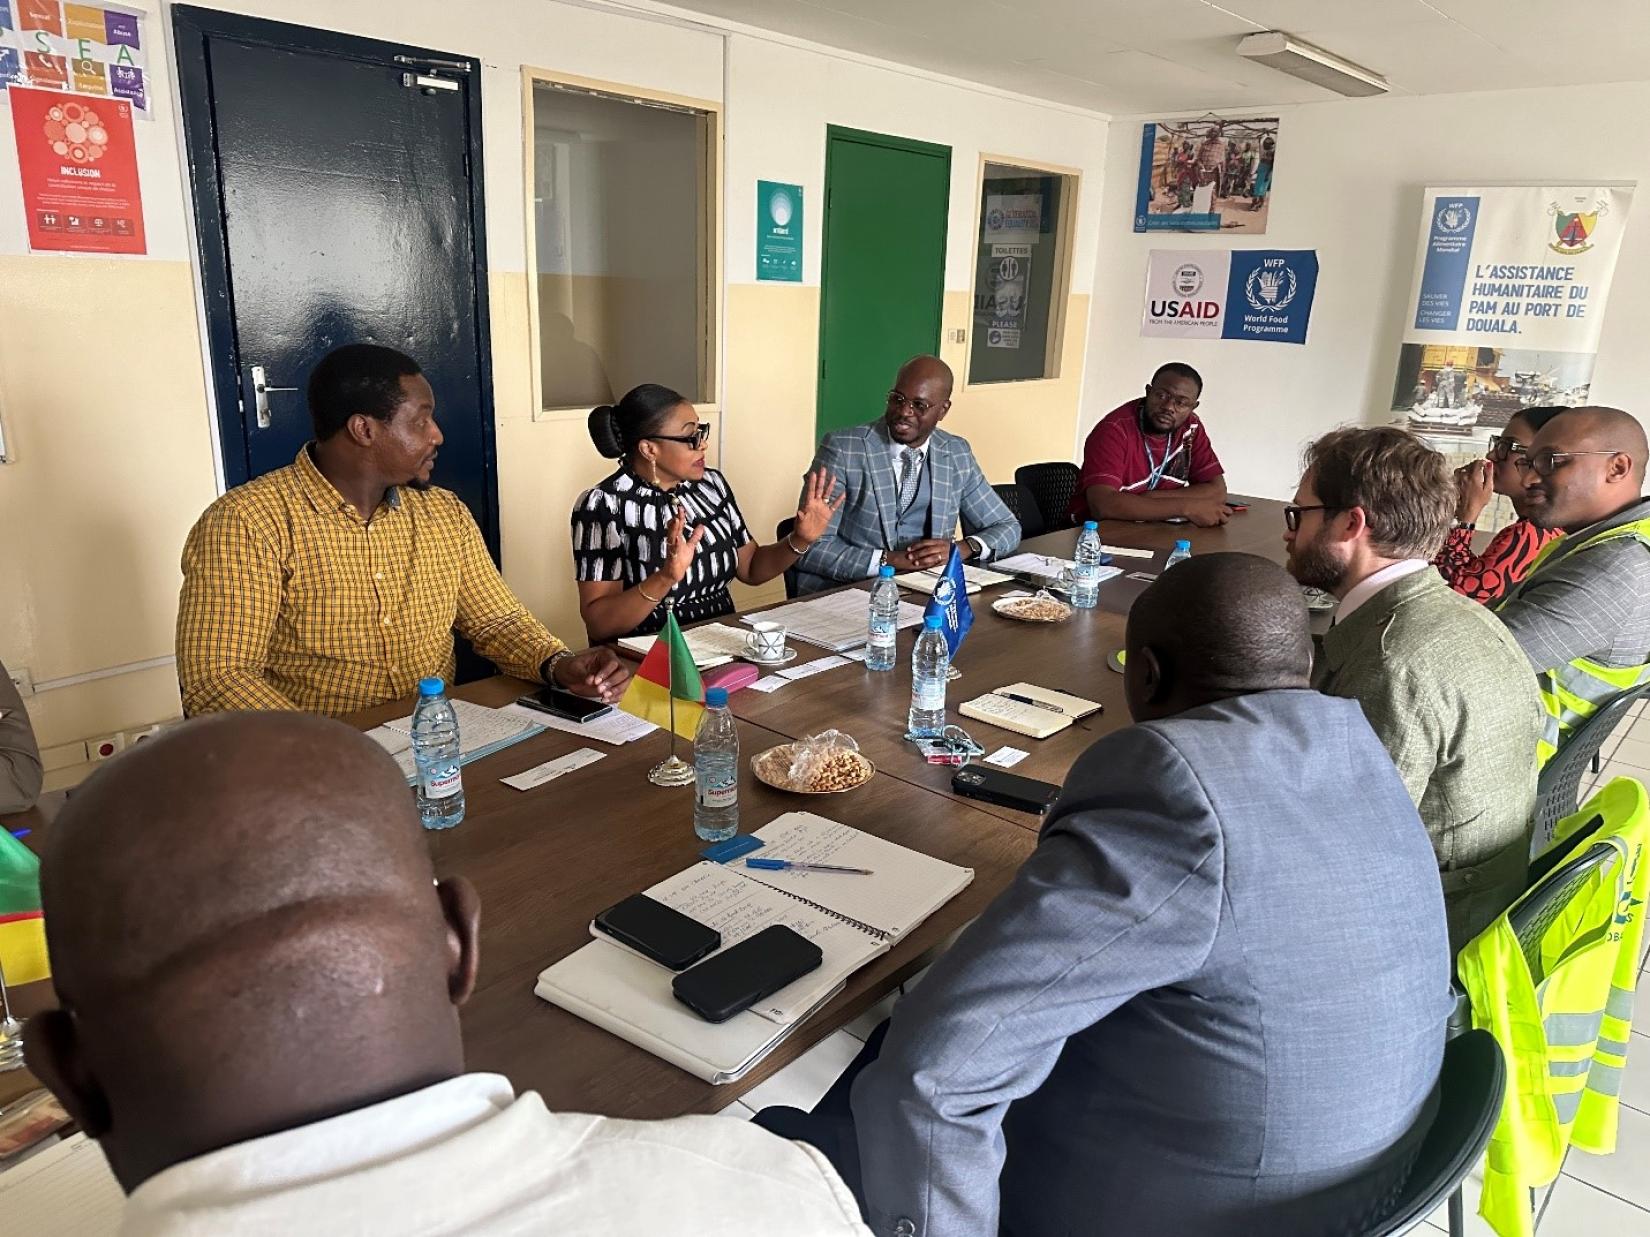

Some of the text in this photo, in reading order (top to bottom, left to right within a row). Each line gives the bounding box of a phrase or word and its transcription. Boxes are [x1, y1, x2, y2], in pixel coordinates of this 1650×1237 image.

[60, 166, 101, 178] INCLUSION
[995, 247, 1028, 255] TOILETTES
[1264, 258, 1285, 268] WFP
[1475, 264, 1575, 280] L'ASSISTANCE
[1472, 283, 1589, 300] HUMANITAIRE DU
[1151, 300, 1220, 319] USAID
[1469, 301, 1586, 318] PAM AU PORT DE
[1244, 314, 1289, 324] World Food
[1466, 318, 1522, 334] DOUALA.
[1243, 324, 1289, 334] Programme
